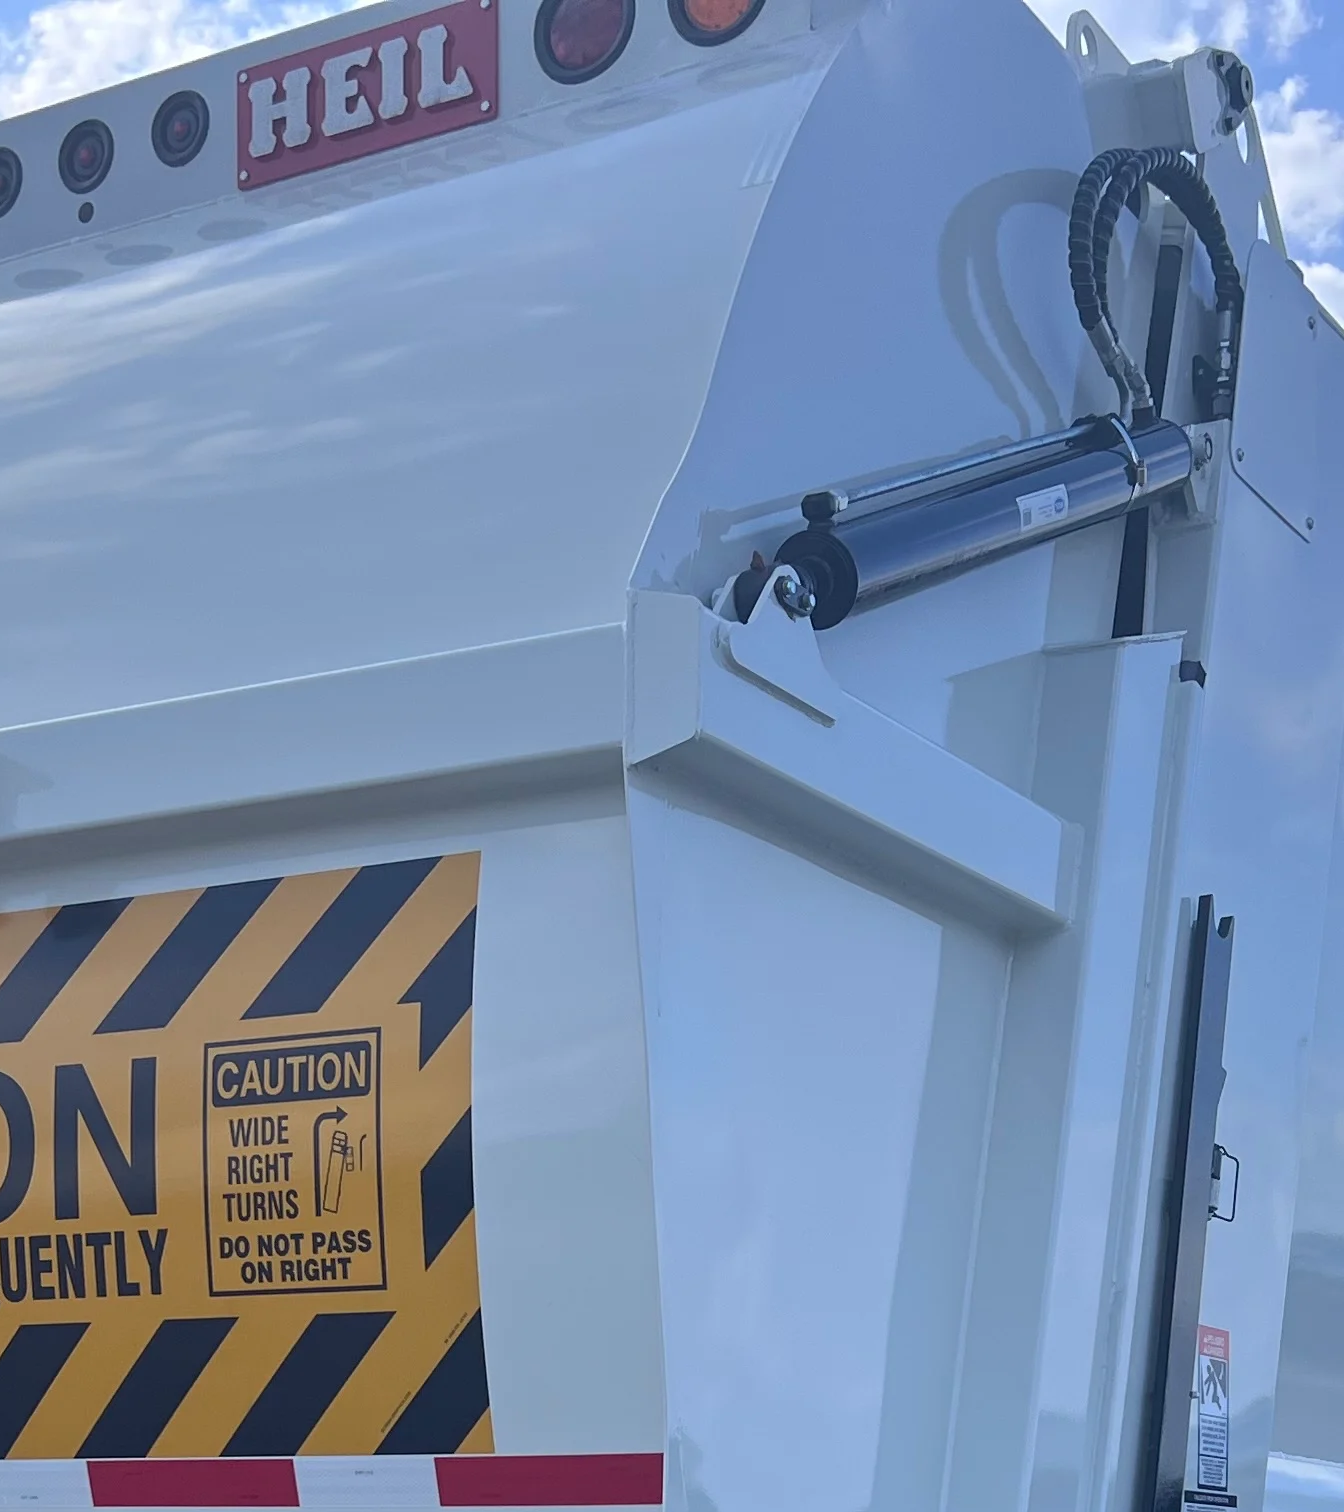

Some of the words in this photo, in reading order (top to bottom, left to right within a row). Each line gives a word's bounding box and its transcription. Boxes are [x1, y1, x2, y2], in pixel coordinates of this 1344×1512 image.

[248, 23, 473, 159] HEIL
[216, 1050, 366, 1099] CAUTION
[229, 1115, 289, 1147] WIDE
[227, 1152, 293, 1185] RIGHT
[223, 1189, 299, 1222] TURNS
[219, 1235, 250, 1259] DO
[257, 1233, 304, 1257] NOT
[312, 1229, 373, 1255] PASS
[241, 1260, 273, 1284] ON
[280, 1257, 352, 1282] RIGHT
